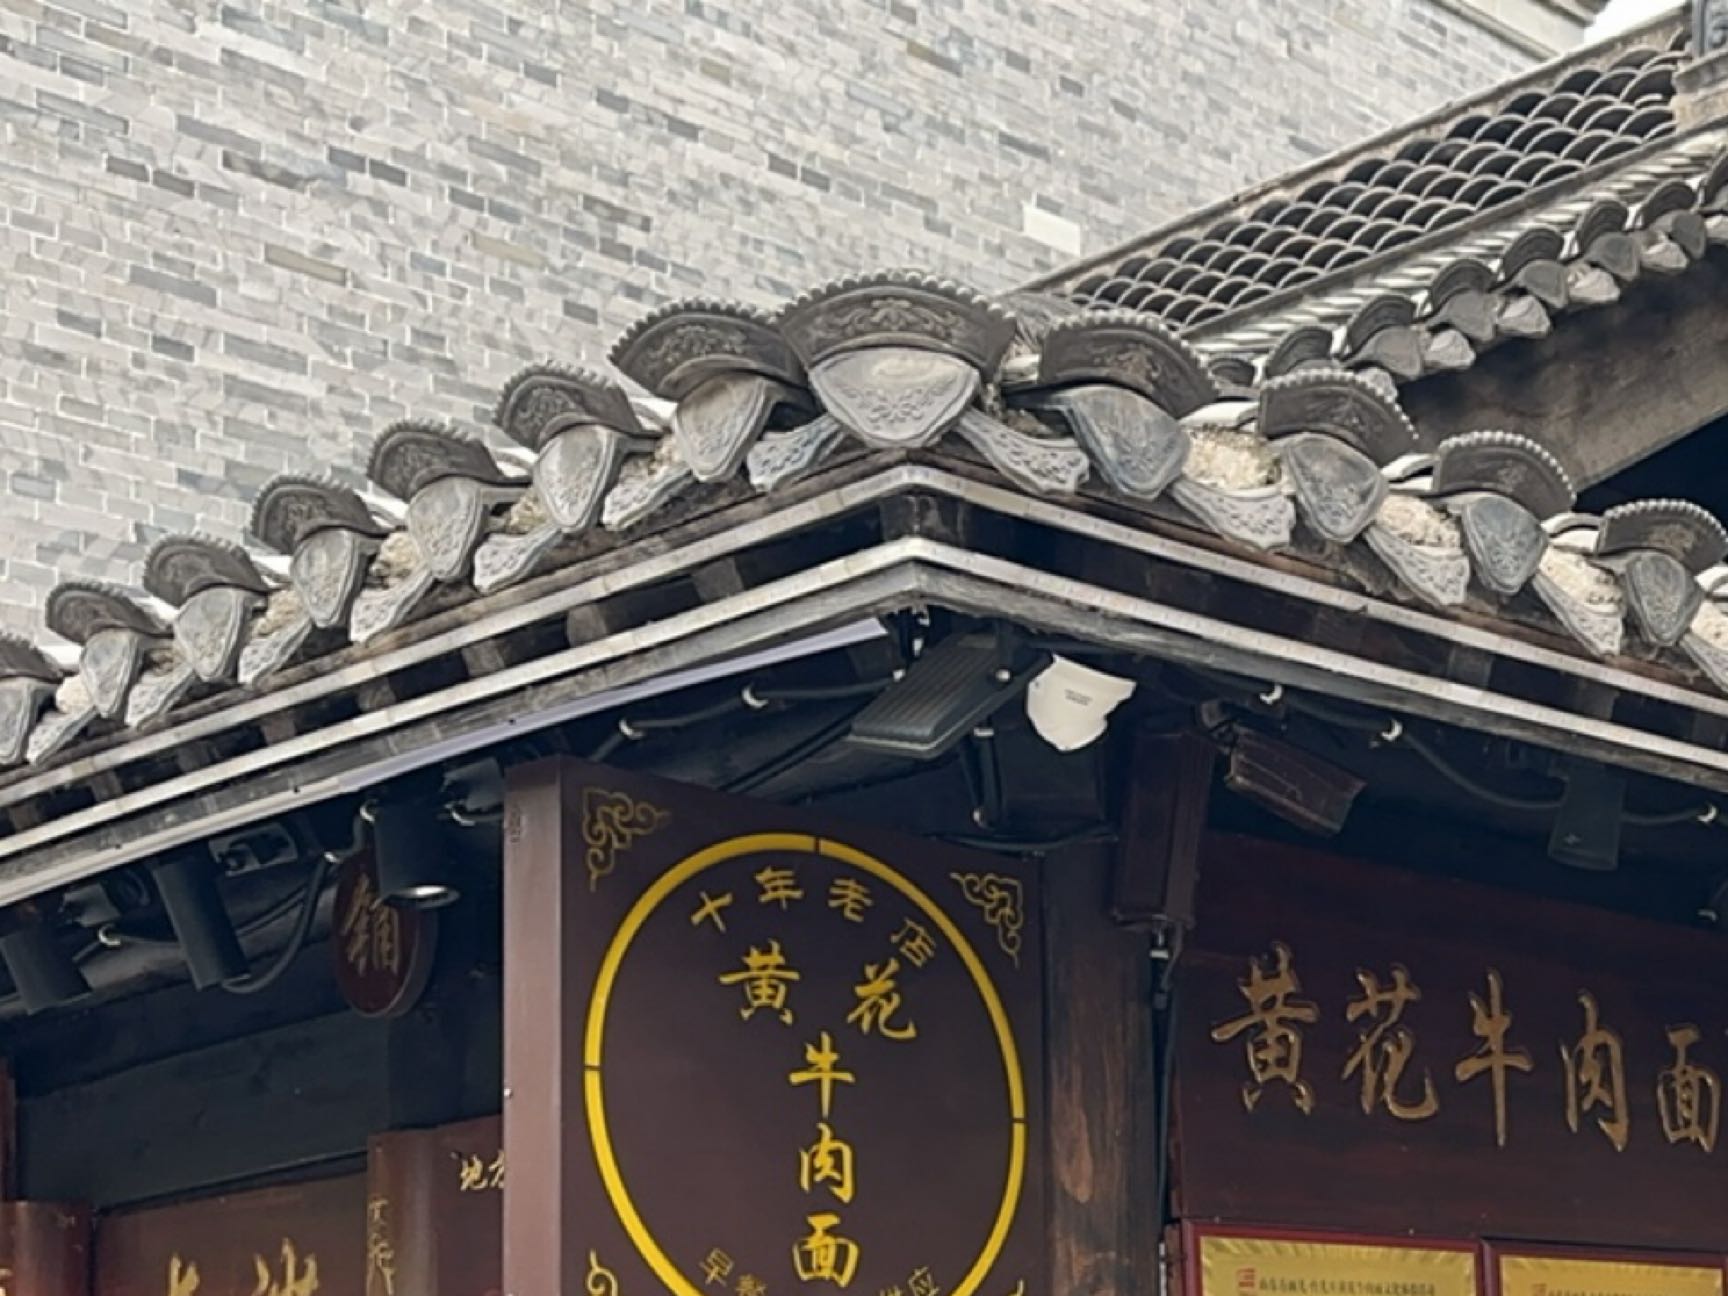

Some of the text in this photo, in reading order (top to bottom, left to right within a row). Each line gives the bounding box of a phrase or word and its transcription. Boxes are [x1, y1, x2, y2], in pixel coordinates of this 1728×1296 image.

[690, 866, 937, 969] 十年老店
[719, 940, 917, 1040] 黄花
[1210, 940, 1722, 1153] 黄花牛肉面
[788, 1032, 859, 1288] 牛肉面
